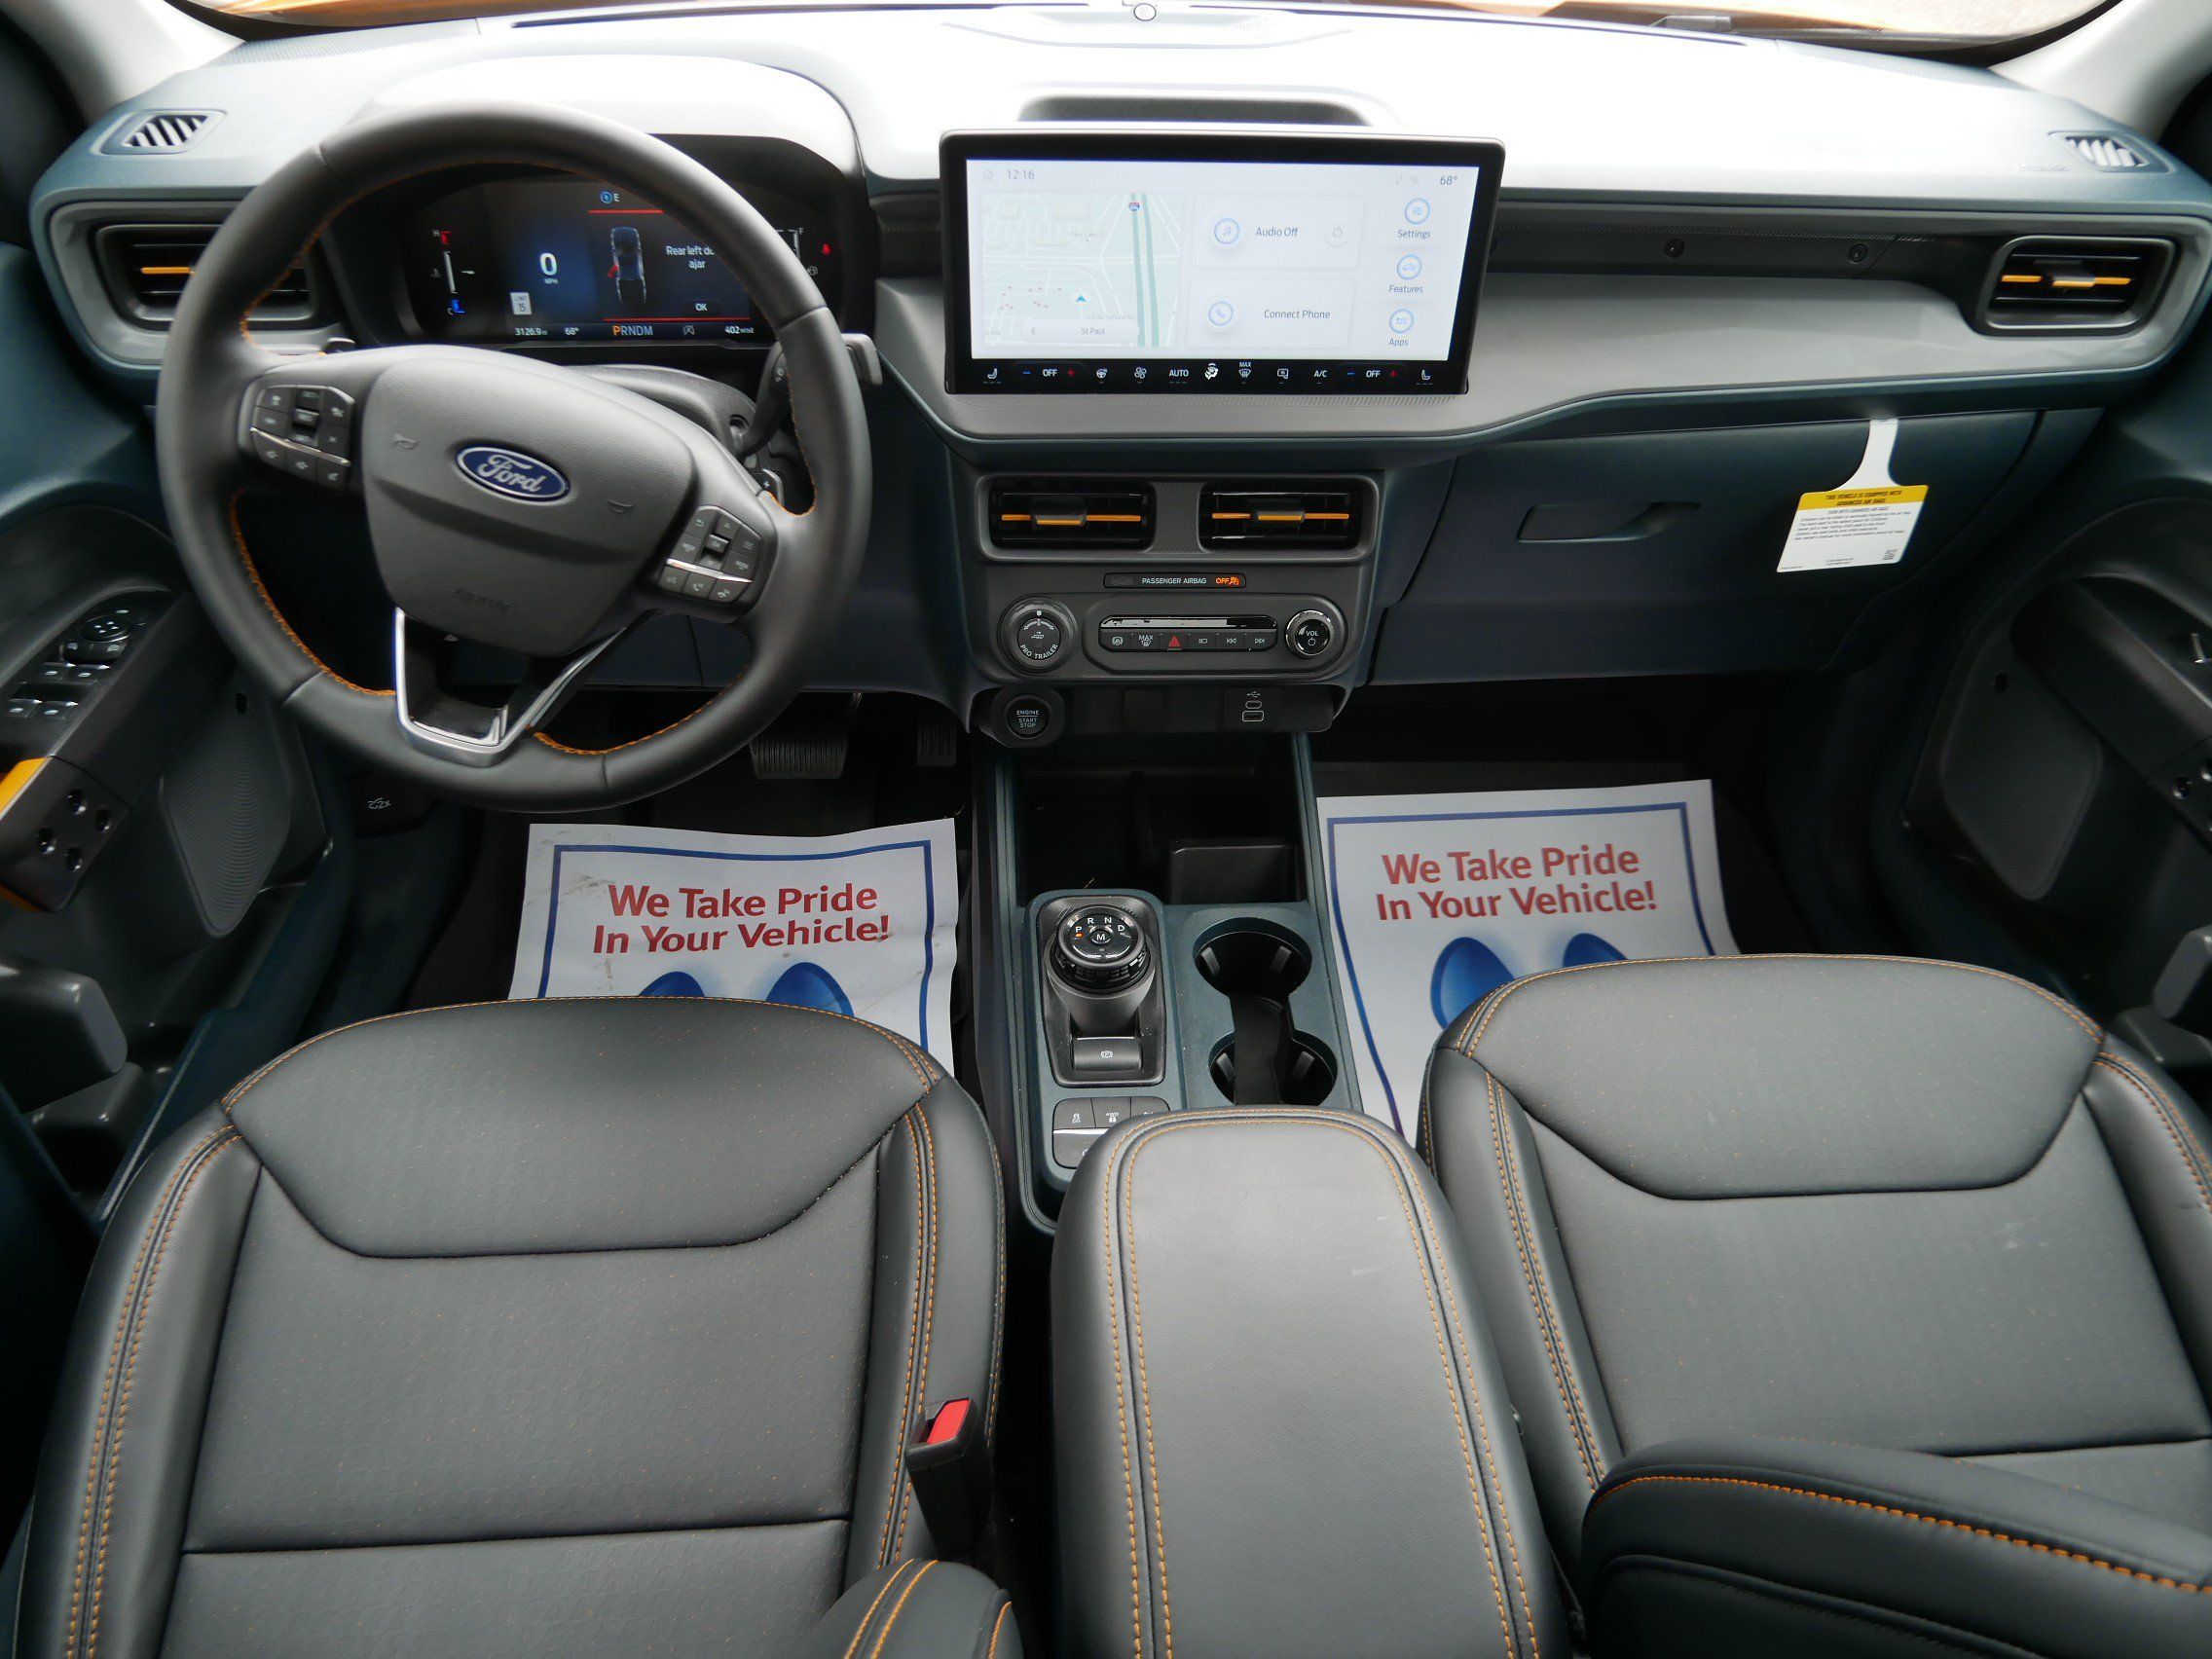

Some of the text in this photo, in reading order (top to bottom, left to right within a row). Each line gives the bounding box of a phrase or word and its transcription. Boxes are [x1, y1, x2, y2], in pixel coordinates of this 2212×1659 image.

[1006, 169, 1035, 180] 12:16
[1439, 175, 1457, 185] 68°
[613, 194, 620, 203] E
[1256, 227, 1300, 237] Audio Off
[1397, 229, 1431, 240] Settings
[666, 245, 685, 255] Rear
[686, 245, 702, 255] left
[539, 252, 558, 276] 0
[688, 259, 706, 270] ajar
[1389, 284, 1423, 294] Features
[694, 303, 708, 313] OK
[1264, 310, 1331, 319] Connect Phone
[1081, 326, 1106, 336] St Paul
[1389, 338, 1409, 348] Apps
[1042, 369, 1058, 378] OFF
[1168, 369, 1189, 378] AUTO
[1313, 370, 1328, 379] A/C
[1365, 370, 1381, 379] OFF
[477, 454, 547, 493] Ford
[1019, 644, 1059, 660] PRO TRAILER
[1381, 842, 1640, 885] We Take Pride
[608, 882, 878, 919] We Take Pride
[1376, 880, 1658, 921] In Your Vehicle!
[593, 914, 890, 954] In Your Vehicle!
